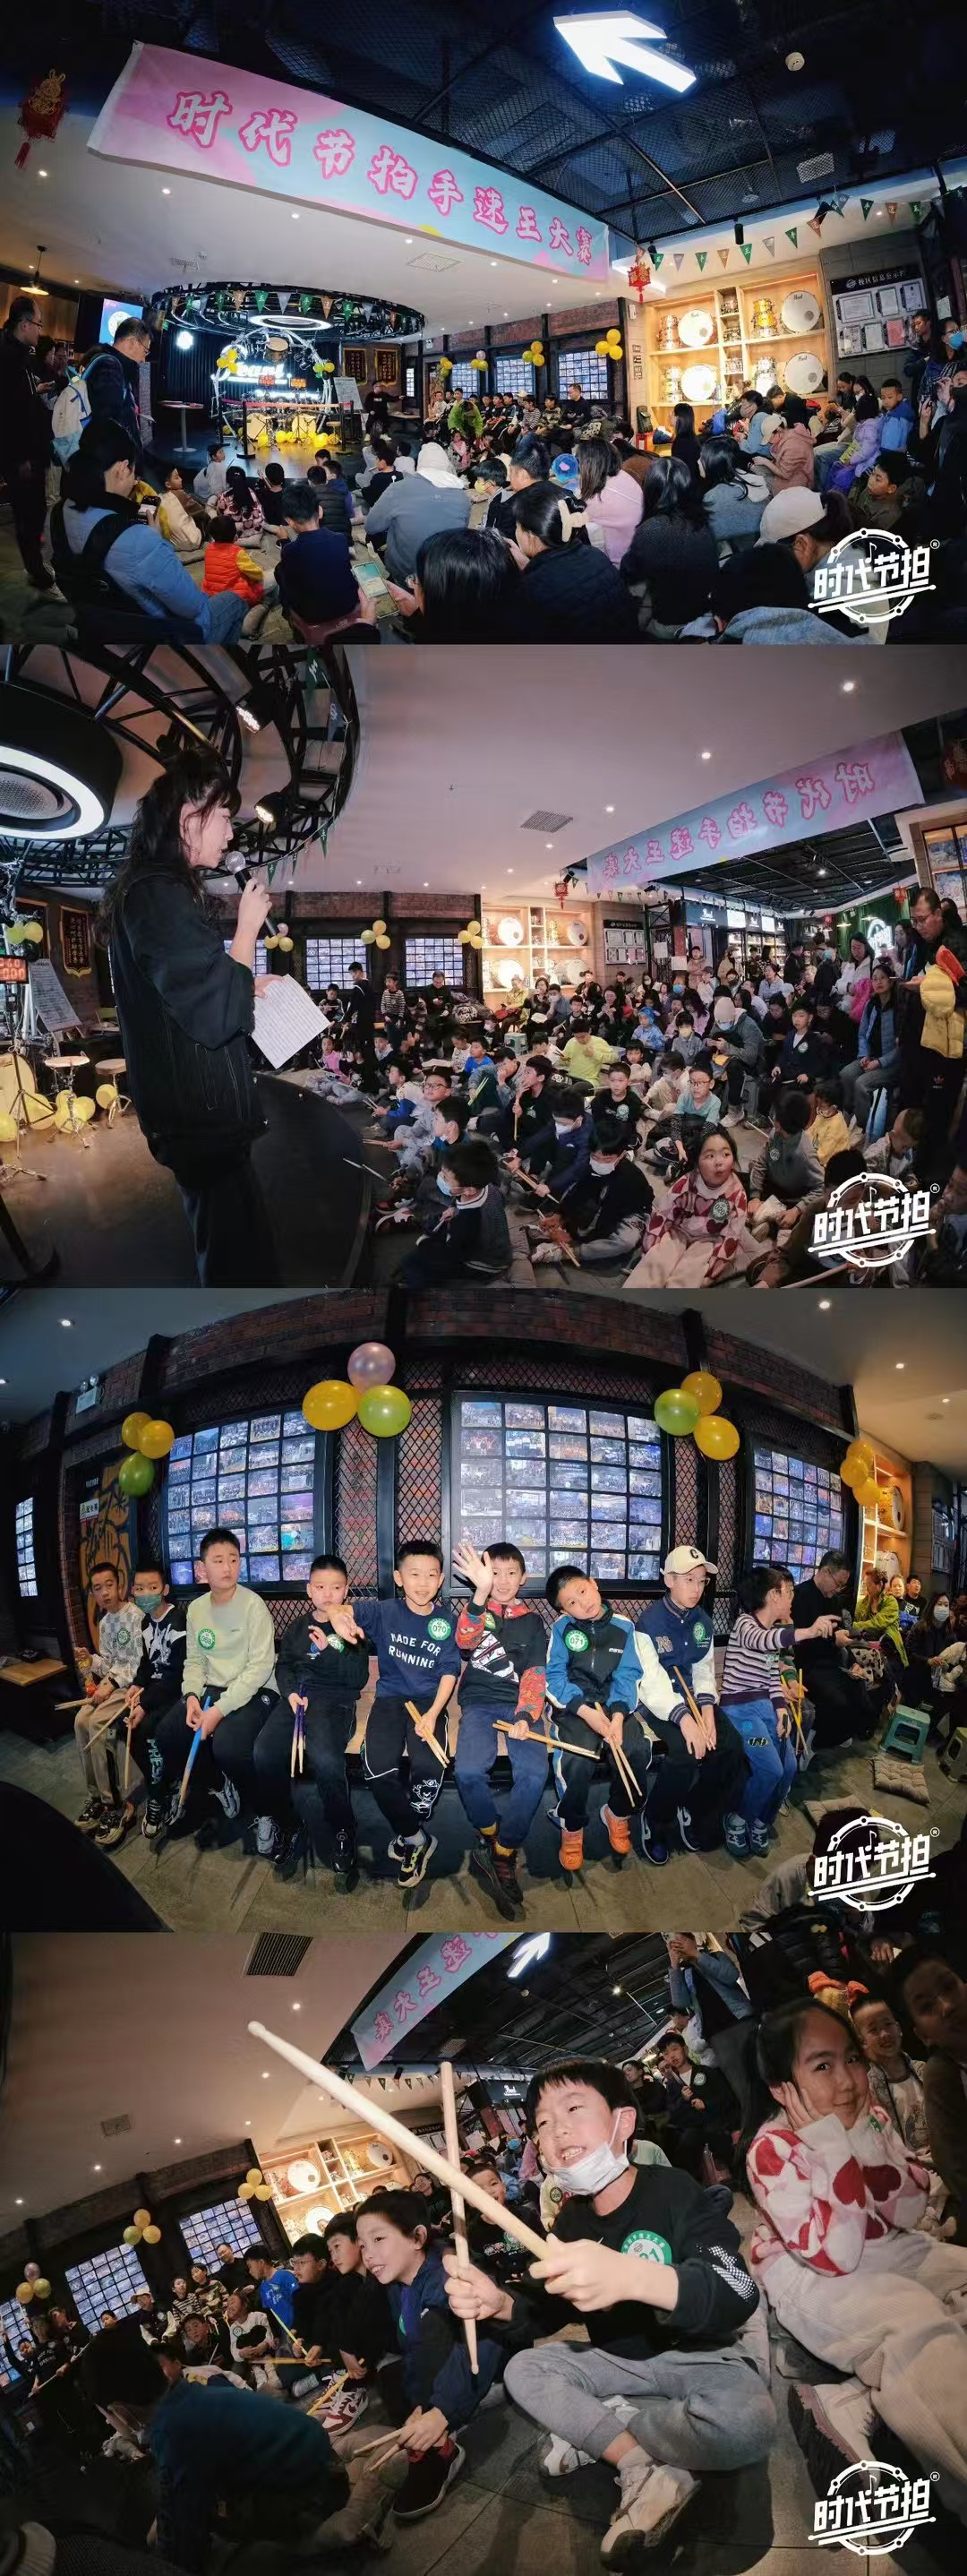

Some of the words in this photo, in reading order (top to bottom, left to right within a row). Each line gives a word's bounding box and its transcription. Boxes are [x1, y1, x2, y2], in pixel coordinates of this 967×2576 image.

[167, 90, 593, 266] 时代节拍手速王大赛
[690, 1549, 699, 1559] C
[432, 1625, 447, 1634] 070
[421, 1640, 441, 1656] FOR
[569, 1636, 583, 1645] 071
[655, 1636, 673, 1653] N
[389, 1645, 436, 1669] RUNNING
